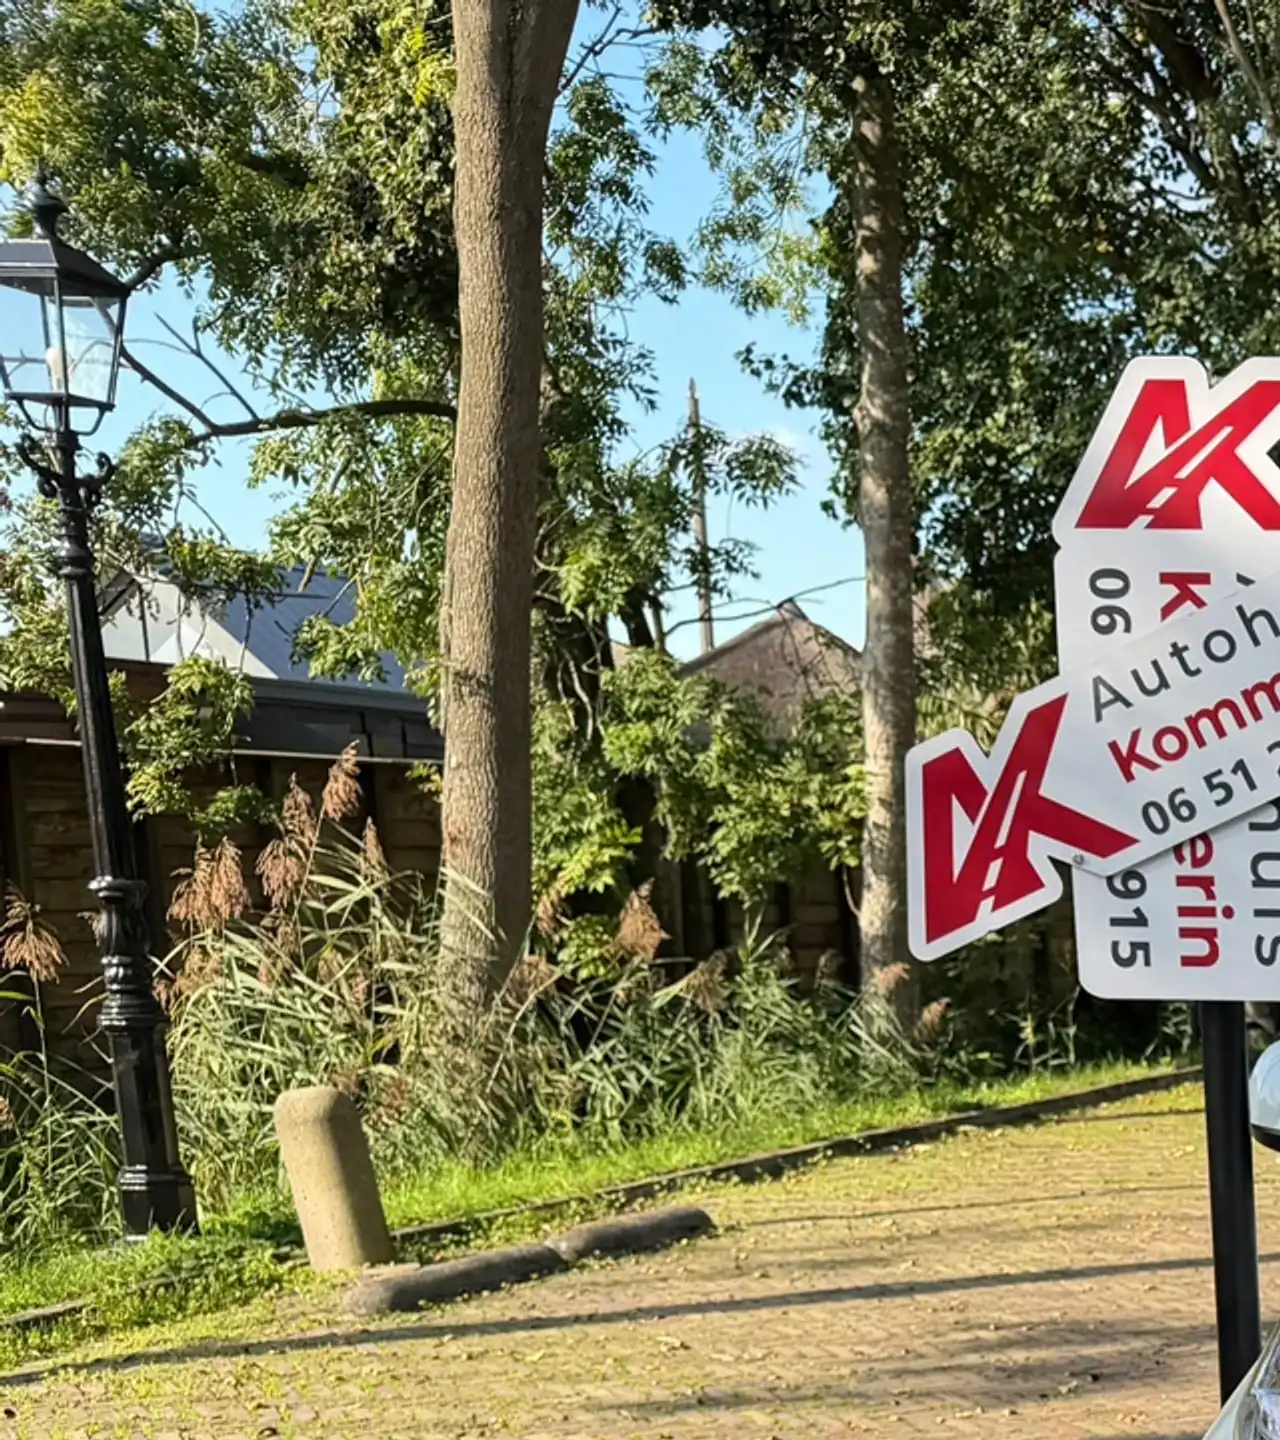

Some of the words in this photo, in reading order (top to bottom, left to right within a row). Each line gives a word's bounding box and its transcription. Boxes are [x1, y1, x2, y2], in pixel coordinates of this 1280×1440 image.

[1089, 567, 1132, 636] 06
[921, 691, 1140, 944] AK
[1141, 787, 1197, 835] 06
[1203, 758, 1259, 807] 51
[1106, 868, 1151, 968] 915
